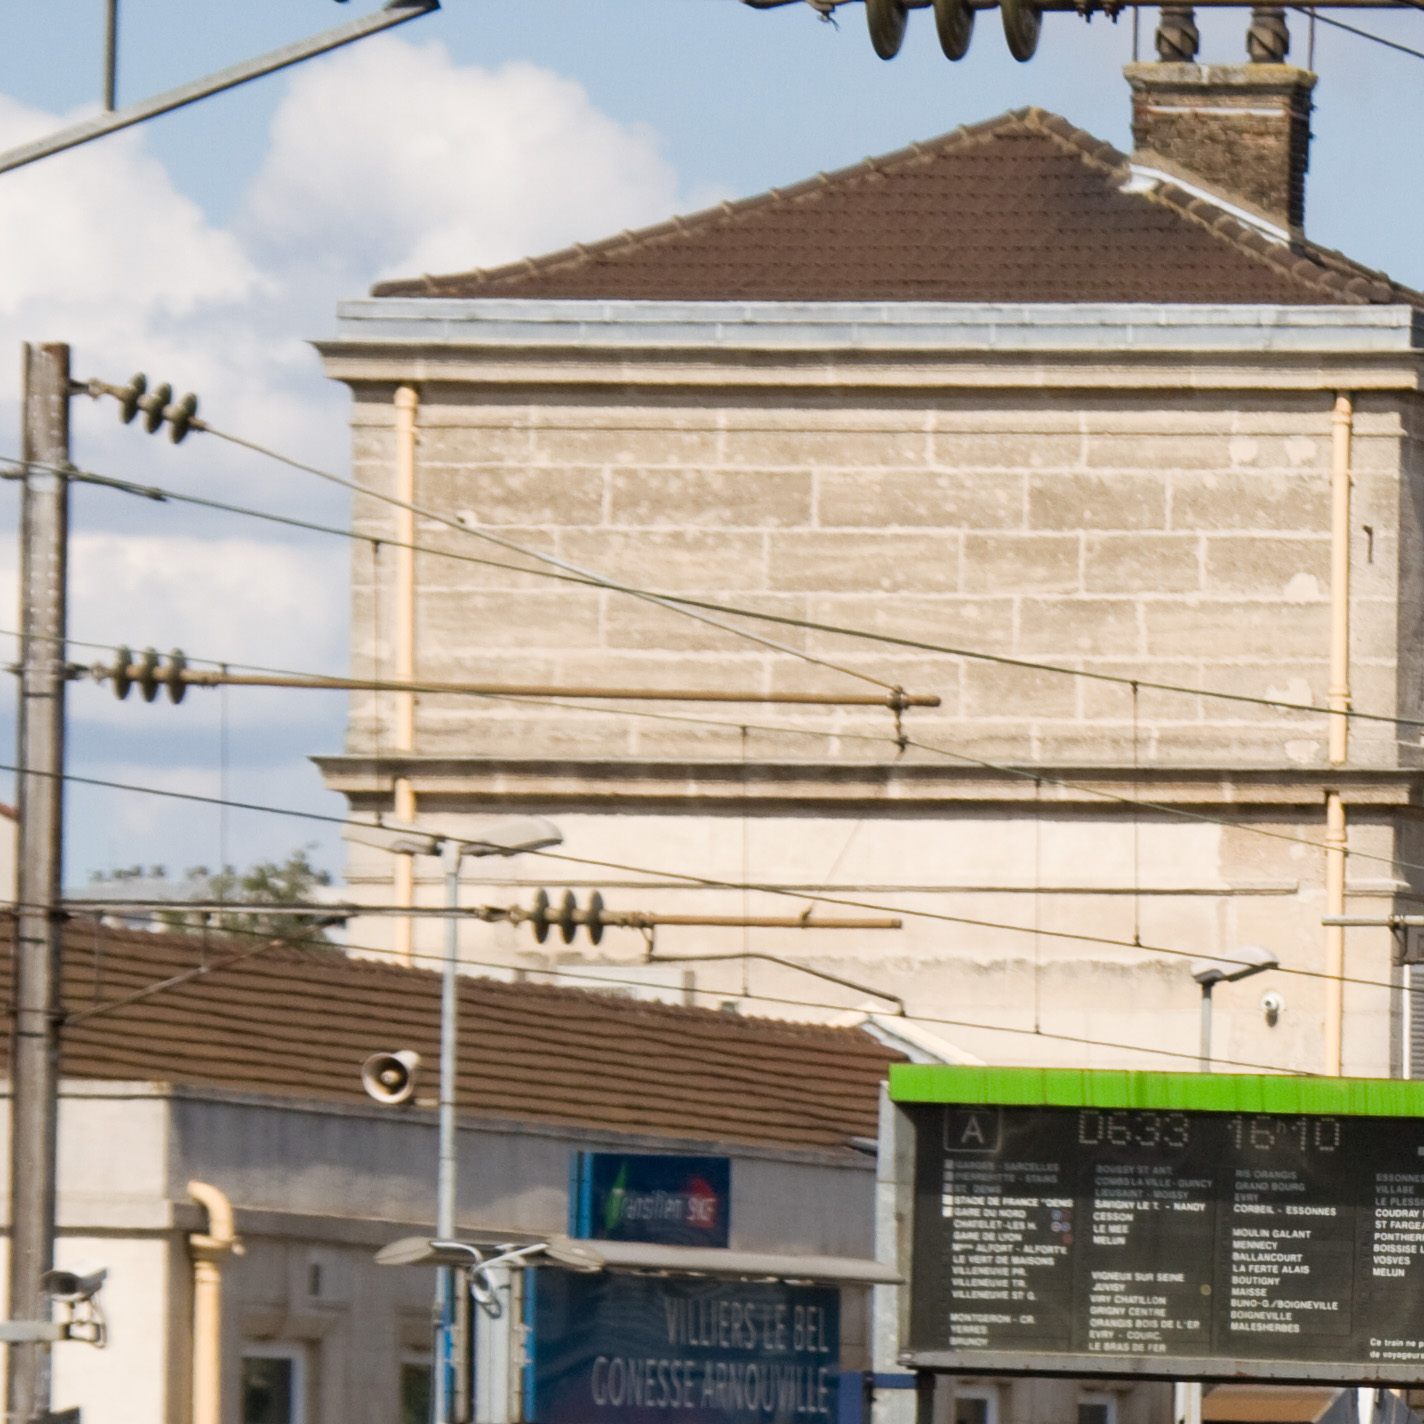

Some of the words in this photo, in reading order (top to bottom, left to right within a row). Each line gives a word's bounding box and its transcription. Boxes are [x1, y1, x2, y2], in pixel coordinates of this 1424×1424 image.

[962, 1117, 984, 1144] A
[1375, 1209, 1419, 1218] COUDRAY
[1375, 1220, 1387, 1229] ST
[664, 1296, 757, 1350] VILLIERS
[793, 1305, 829, 1353] BEL
[1369, 1338, 1382, 1347] Ce
[1383, 1339, 1404, 1347] train
[1382, 1352, 1424, 1360] voyageurs
[591, 1356, 696, 1408] GONESSE
[700, 1360, 829, 1413] ARNOUVILLE
